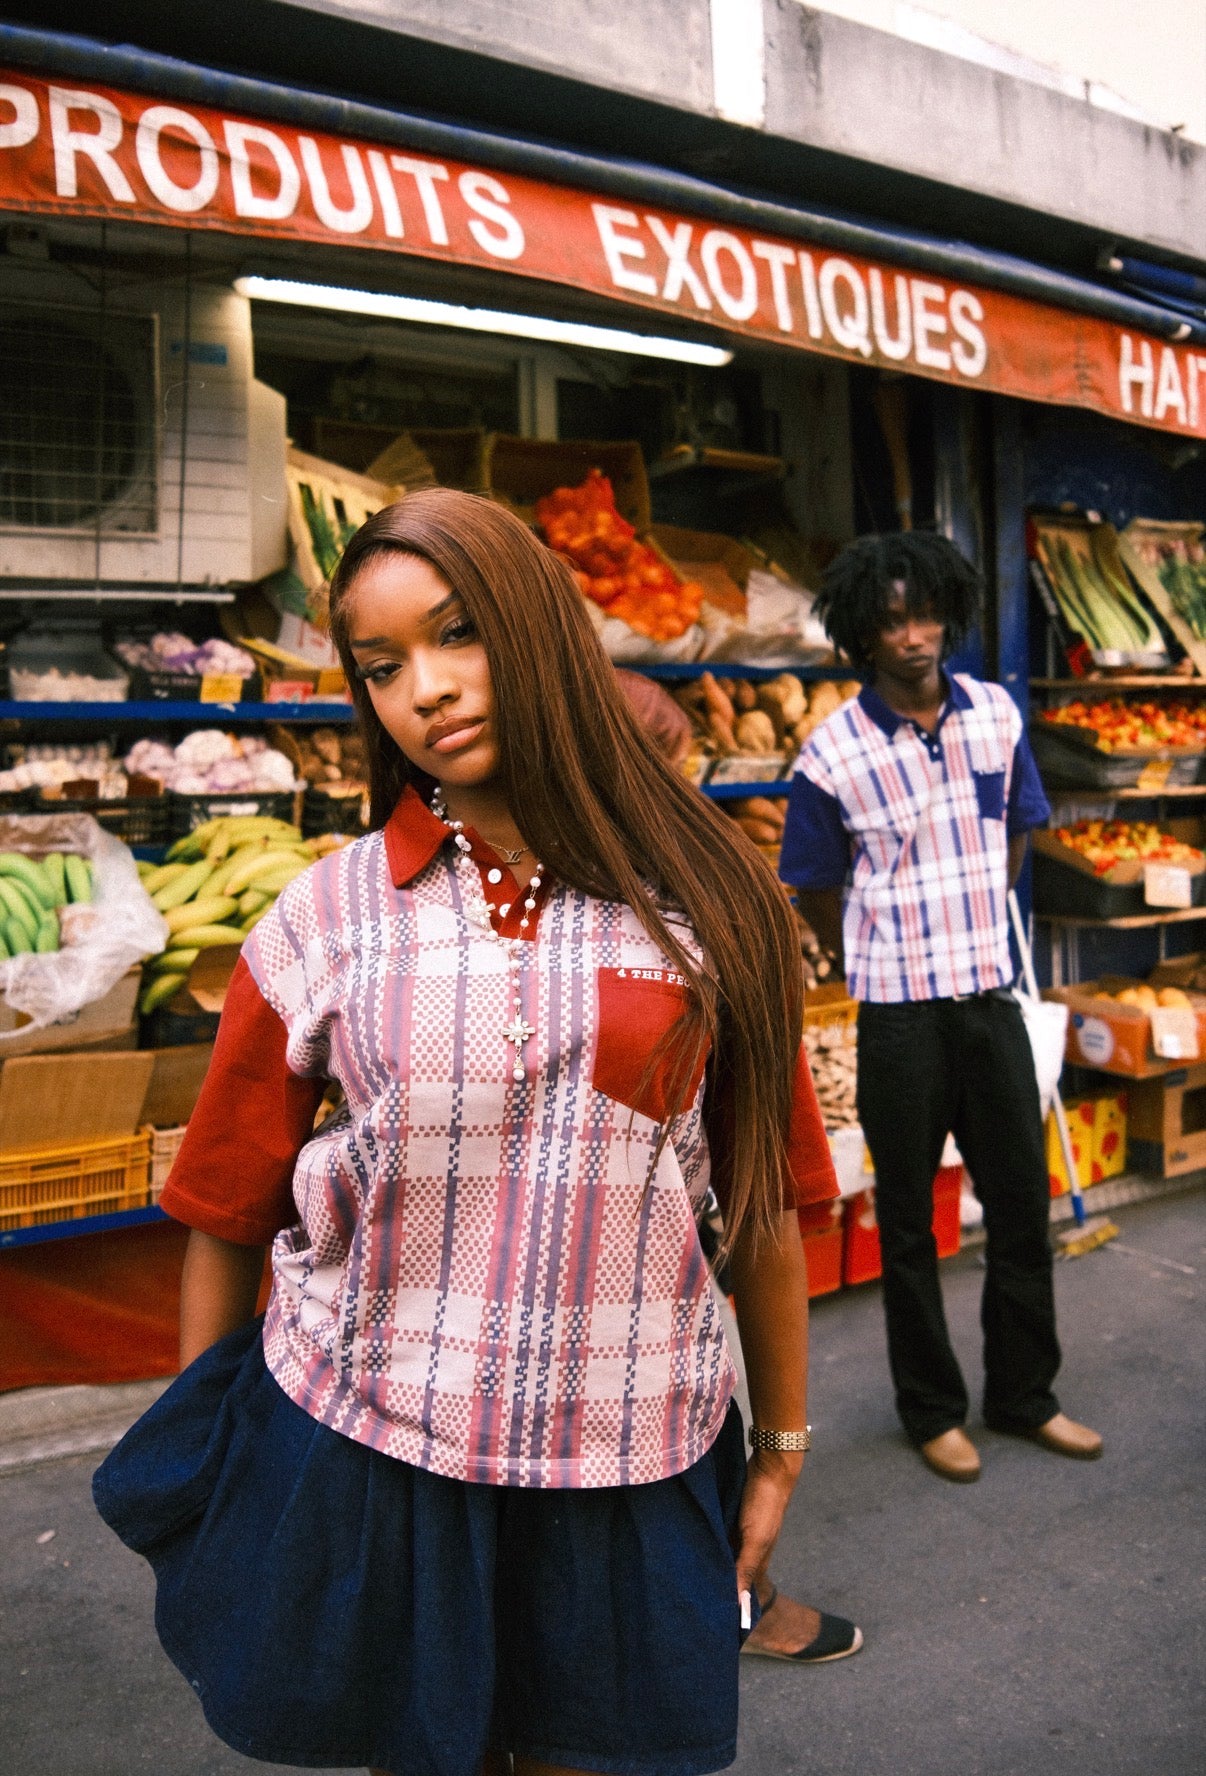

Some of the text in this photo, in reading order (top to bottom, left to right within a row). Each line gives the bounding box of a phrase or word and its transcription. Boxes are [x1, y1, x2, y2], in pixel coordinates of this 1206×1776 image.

[591, 203, 988, 378] EXOTIQUES
[1118, 332, 1206, 429] HAI
[617, 968, 627, 978] 4
[631, 969, 662, 980] THE
